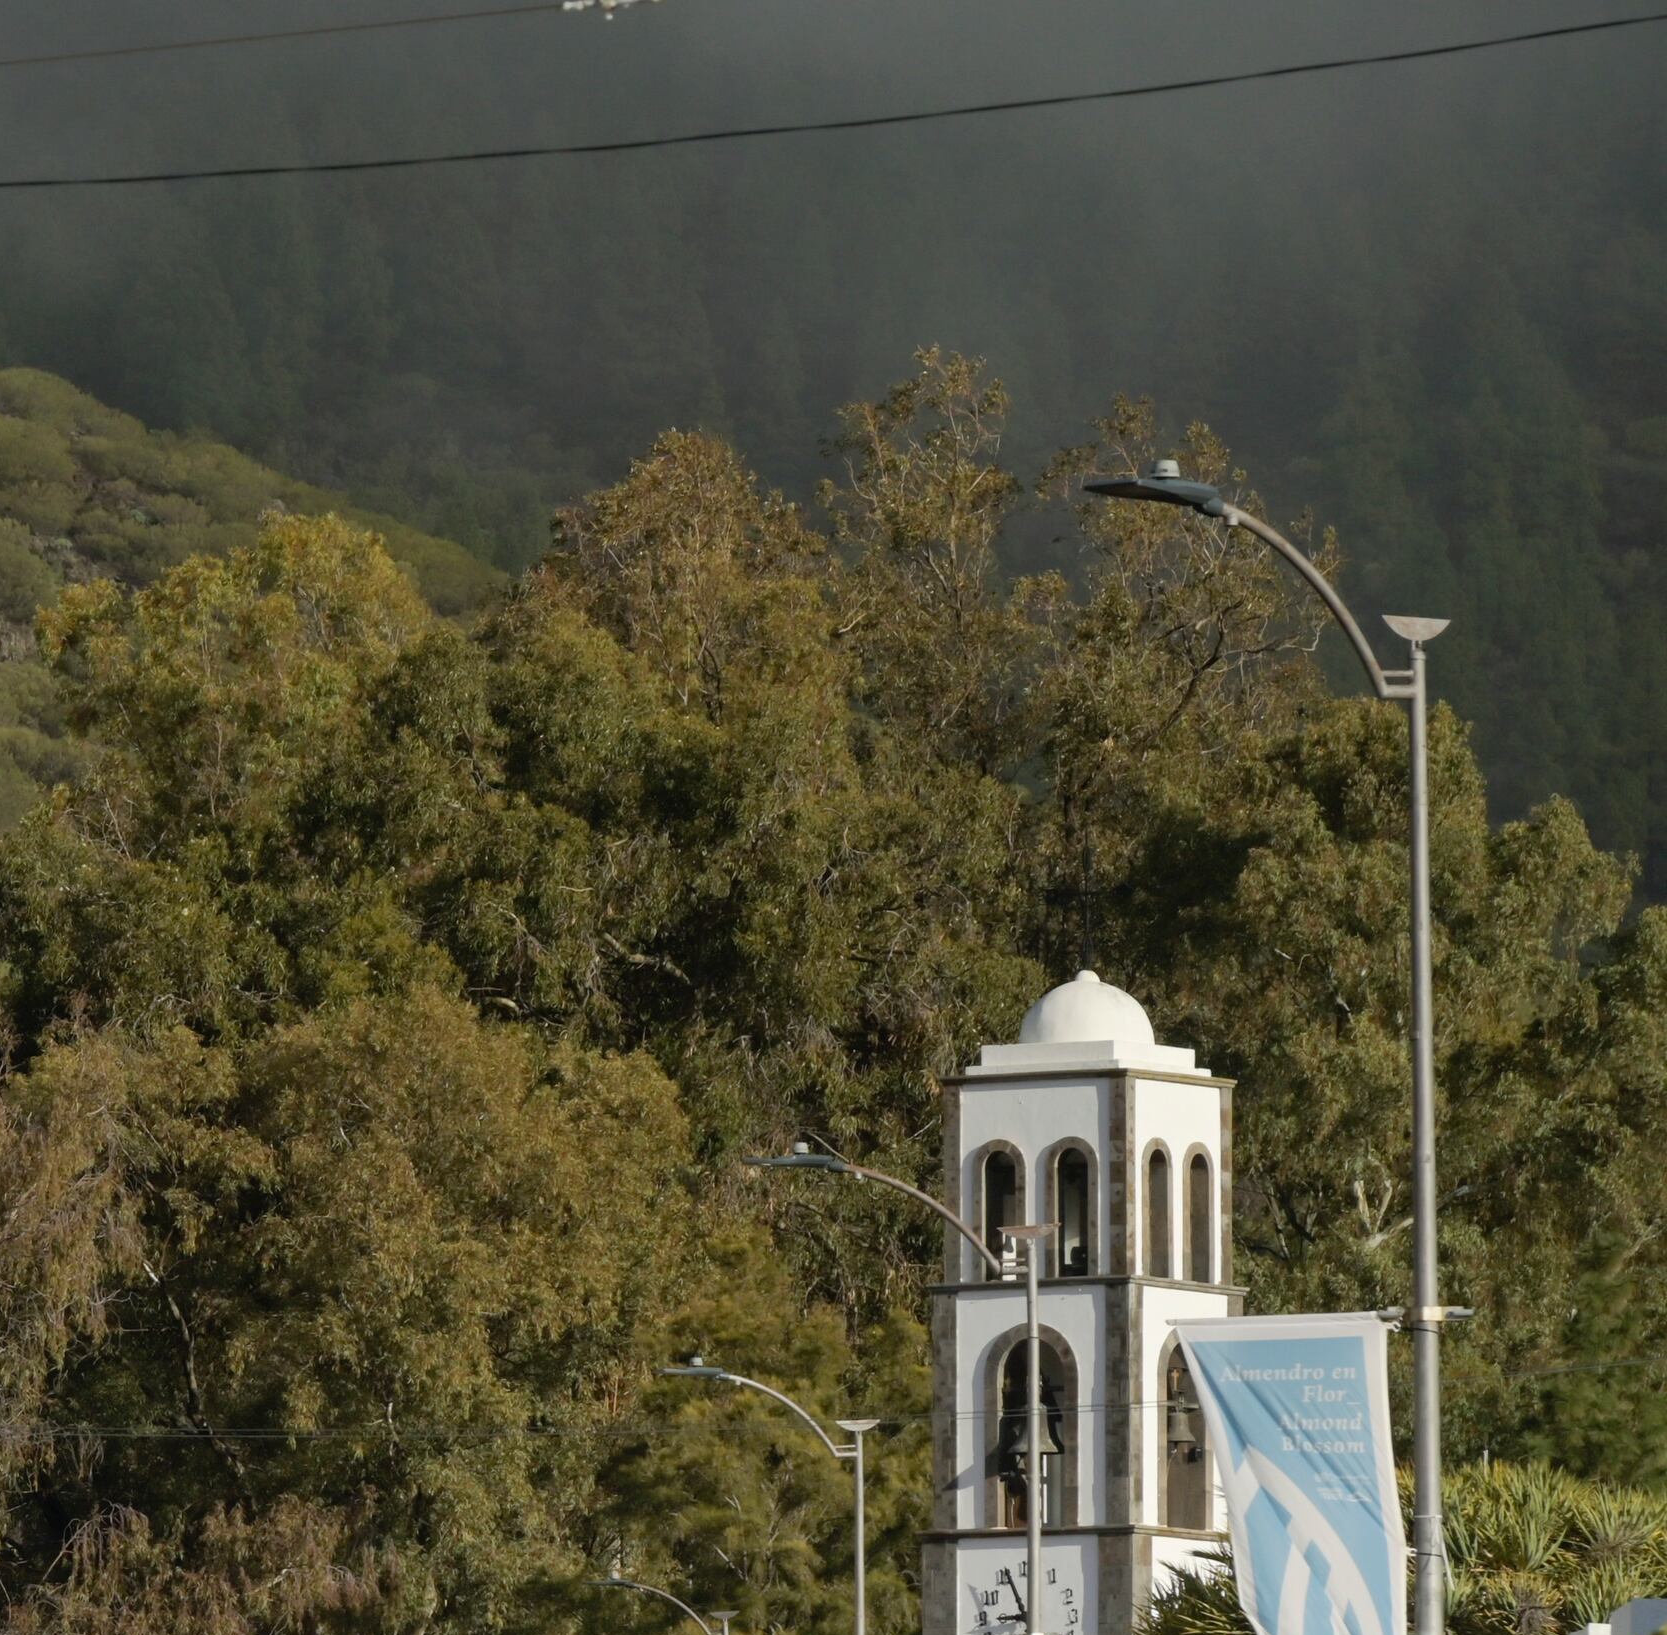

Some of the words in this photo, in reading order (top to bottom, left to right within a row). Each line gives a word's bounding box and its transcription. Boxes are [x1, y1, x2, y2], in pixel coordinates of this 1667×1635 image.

[1220, 1363, 1324, 1382] Almendro
[1332, 1367, 1356, 1380] en
[1277, 1412, 1363, 1431] Almond
[1282, 1435, 1365, 1453] Blossom
